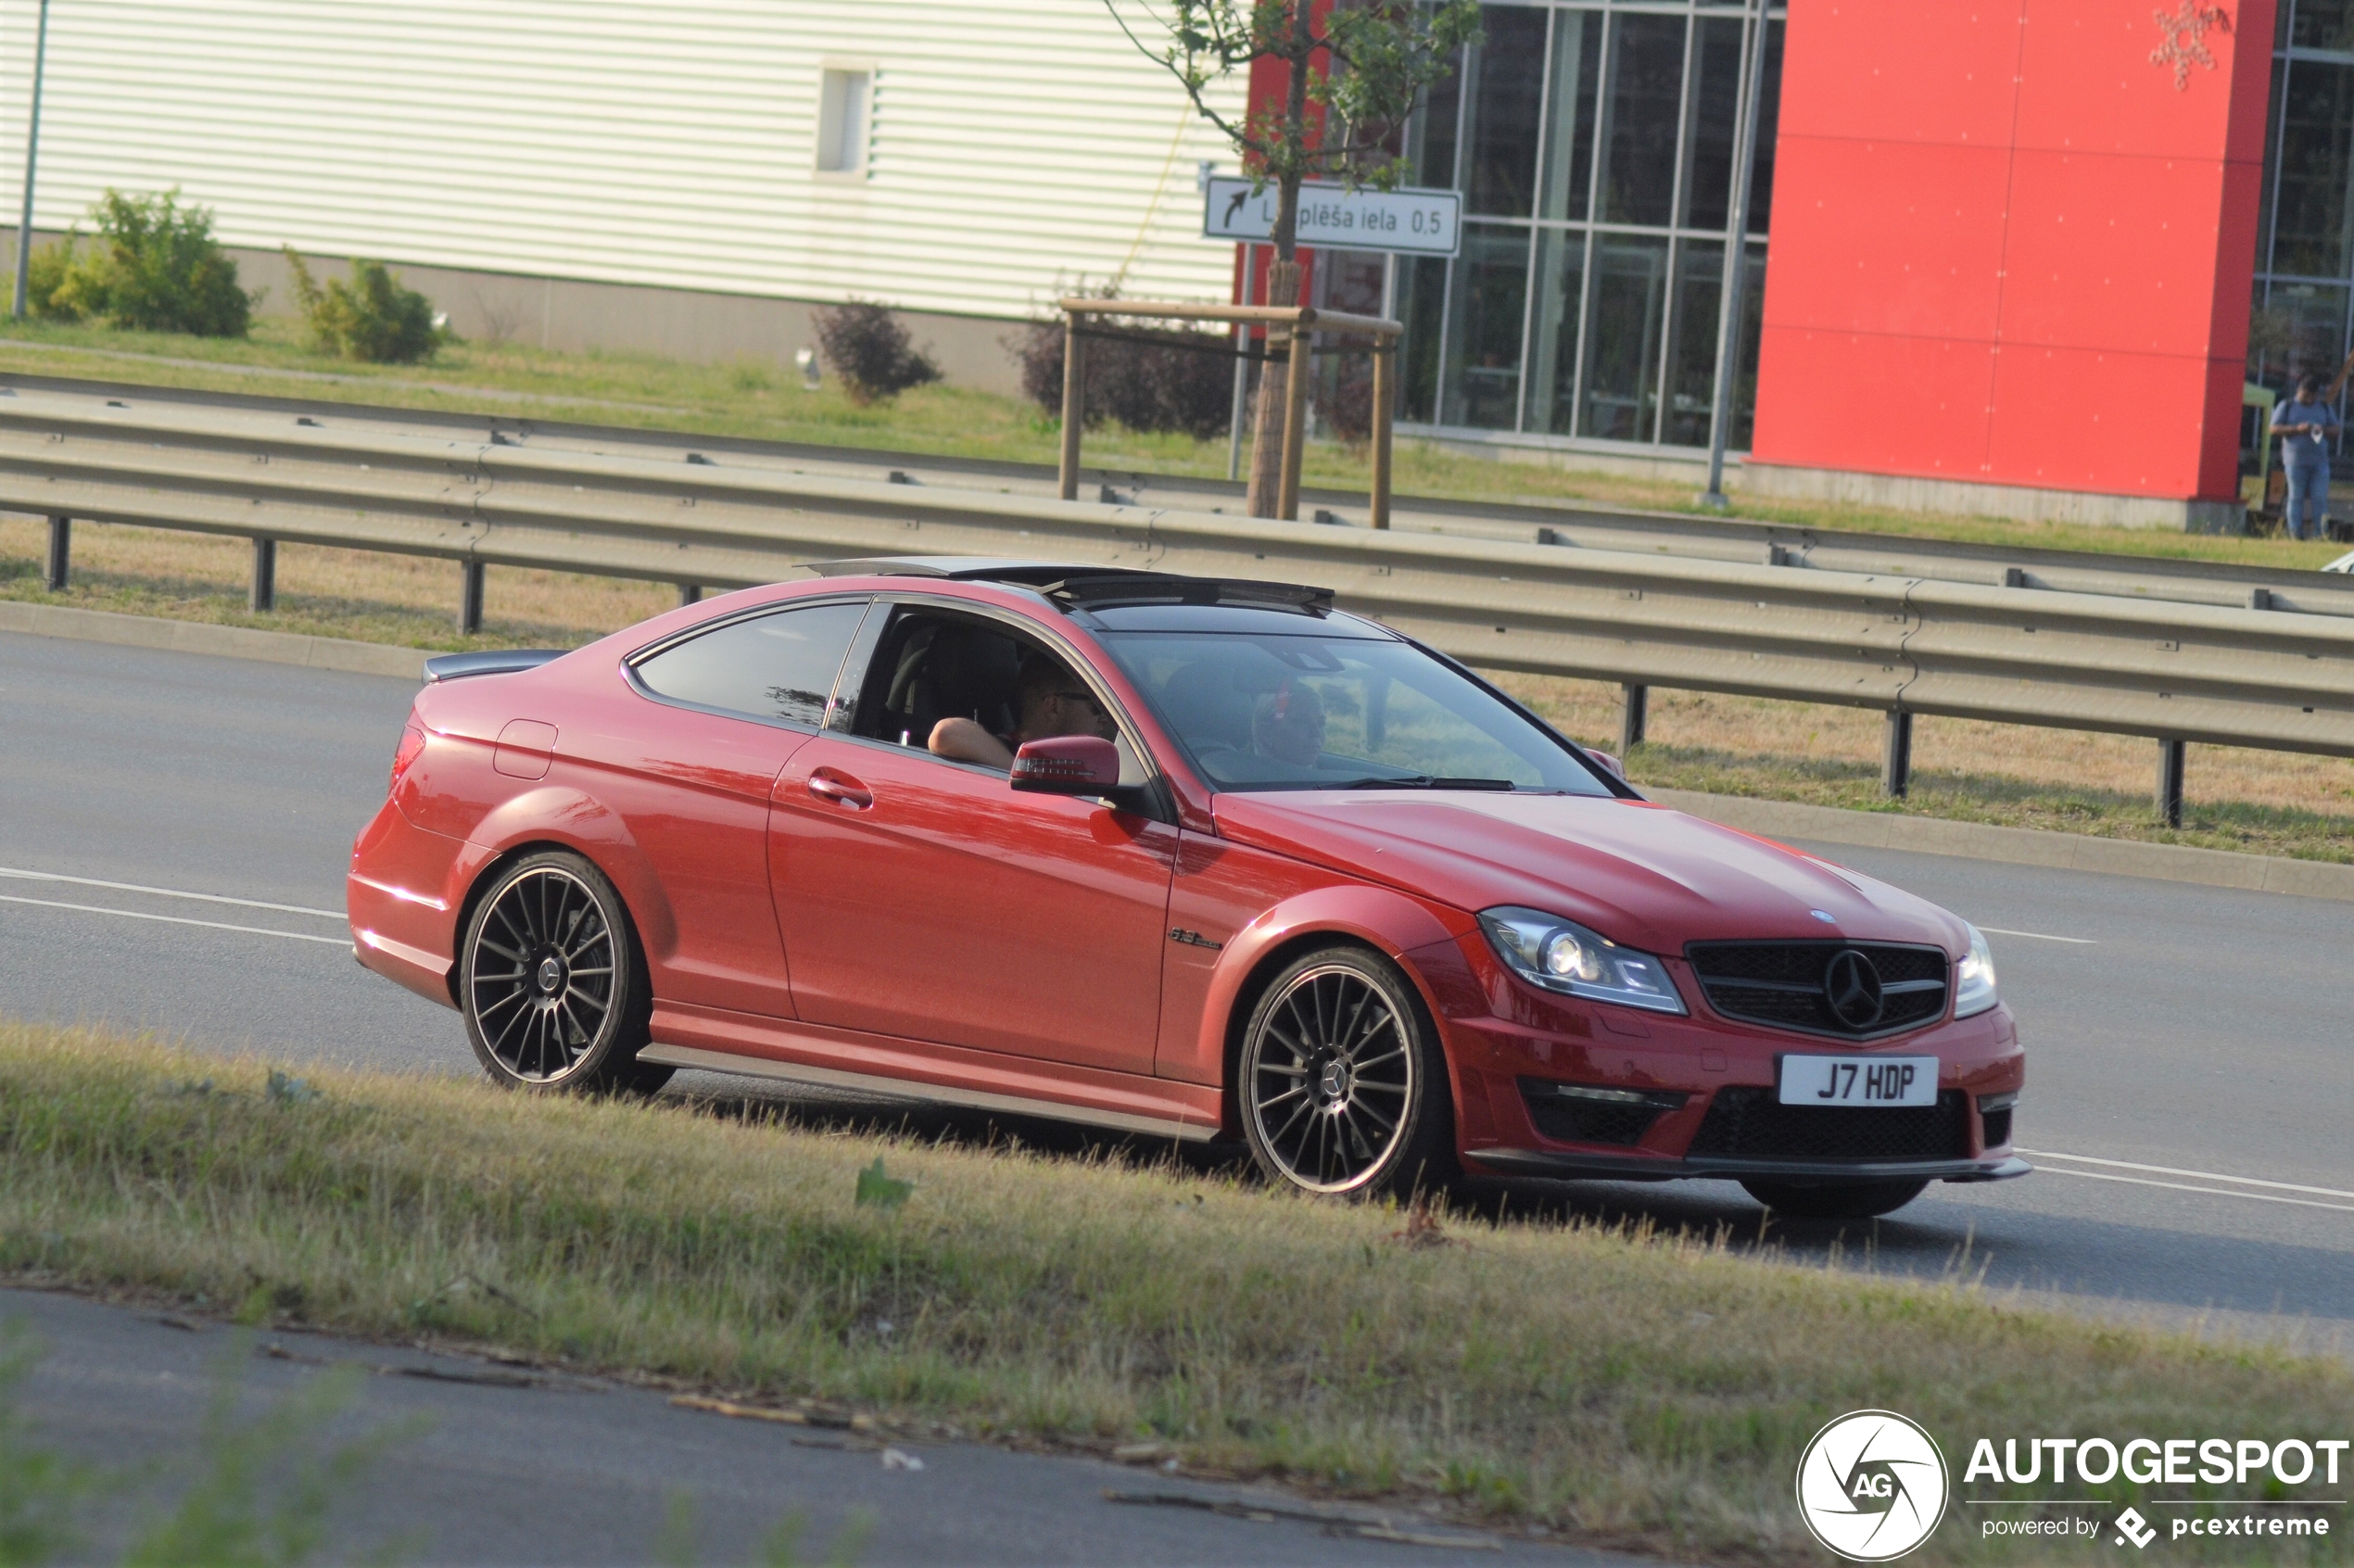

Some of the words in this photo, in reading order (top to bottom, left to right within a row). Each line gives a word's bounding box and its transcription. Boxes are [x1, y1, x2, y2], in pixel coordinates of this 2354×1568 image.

[1262, 200, 1353, 229] Lplēša
[1361, 210, 1397, 230] iela
[1817, 1064, 1858, 1099] J7
[1866, 1065, 1915, 1100] HDP
